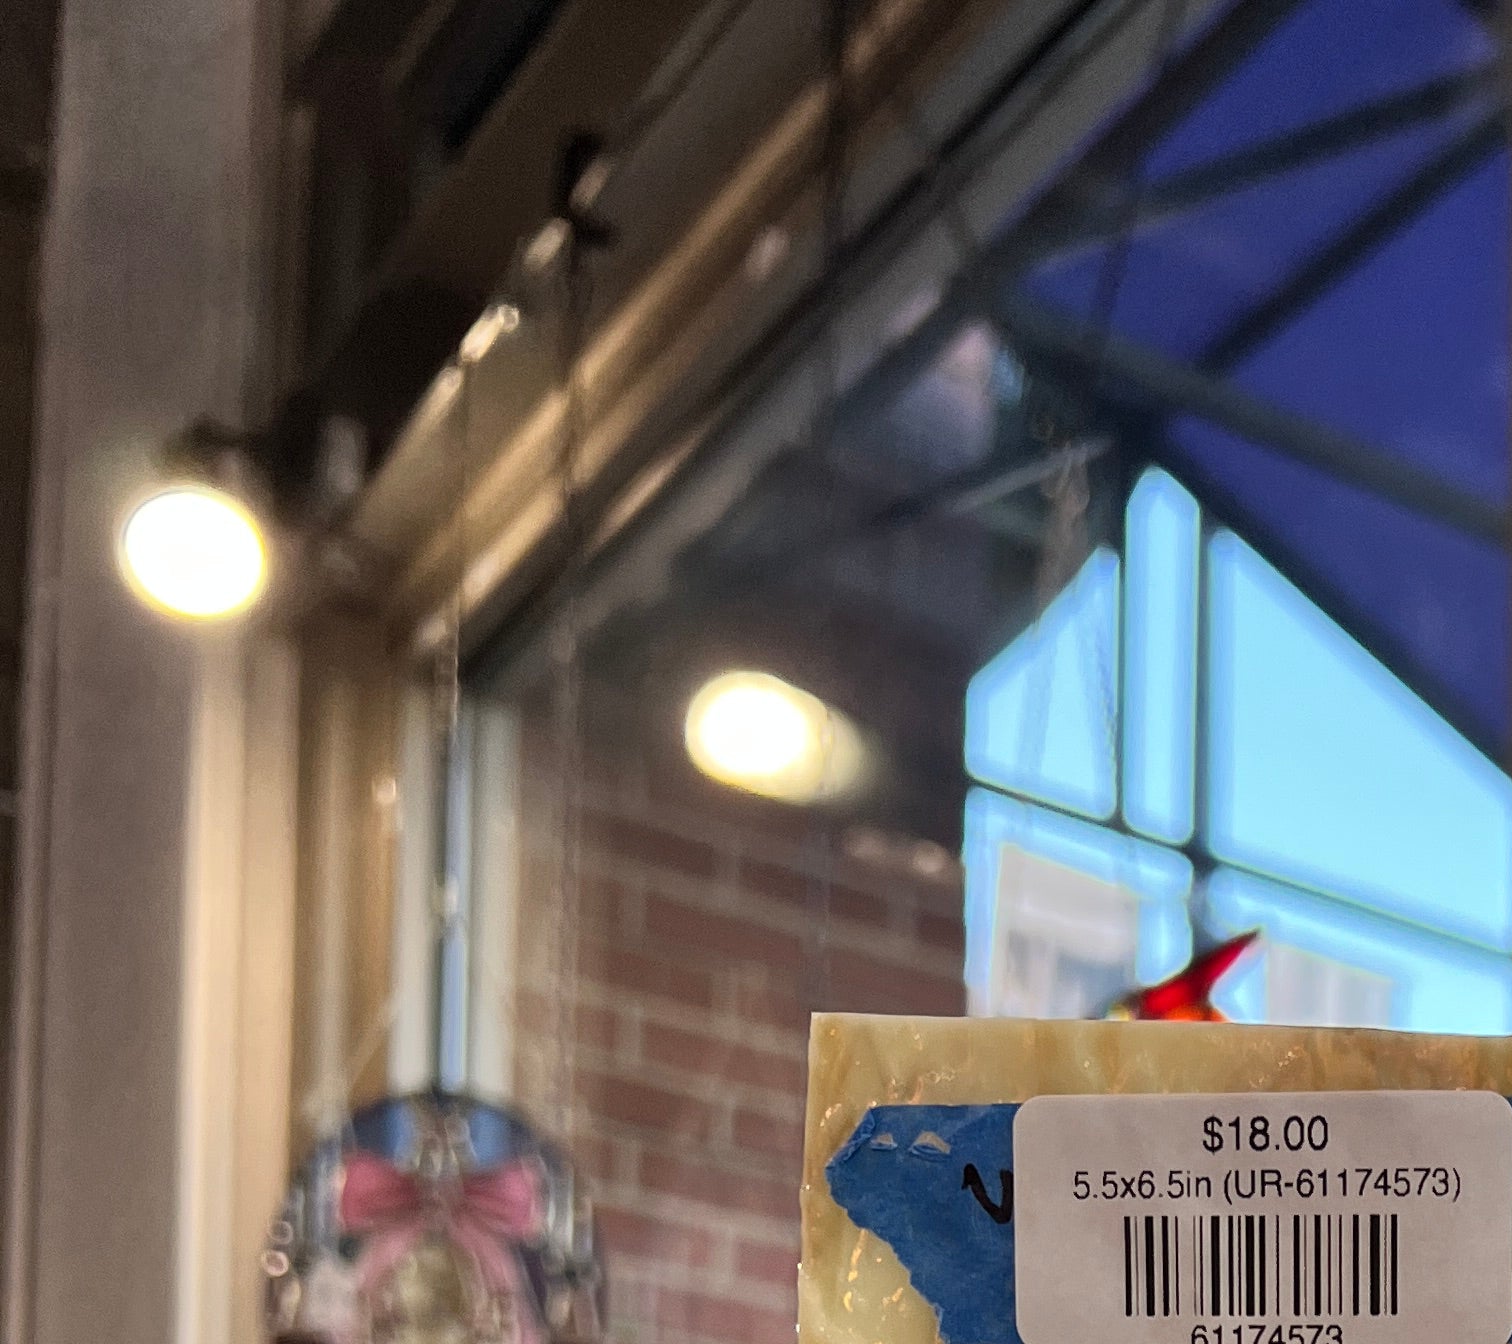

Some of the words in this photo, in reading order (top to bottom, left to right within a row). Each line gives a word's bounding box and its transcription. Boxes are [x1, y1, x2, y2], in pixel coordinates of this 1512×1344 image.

[1202, 1115, 1330, 1155] $18.00
[1072, 1169, 1213, 1200] 5.5x6.5in
[1223, 1167, 1462, 1205] (UR-61174573)
